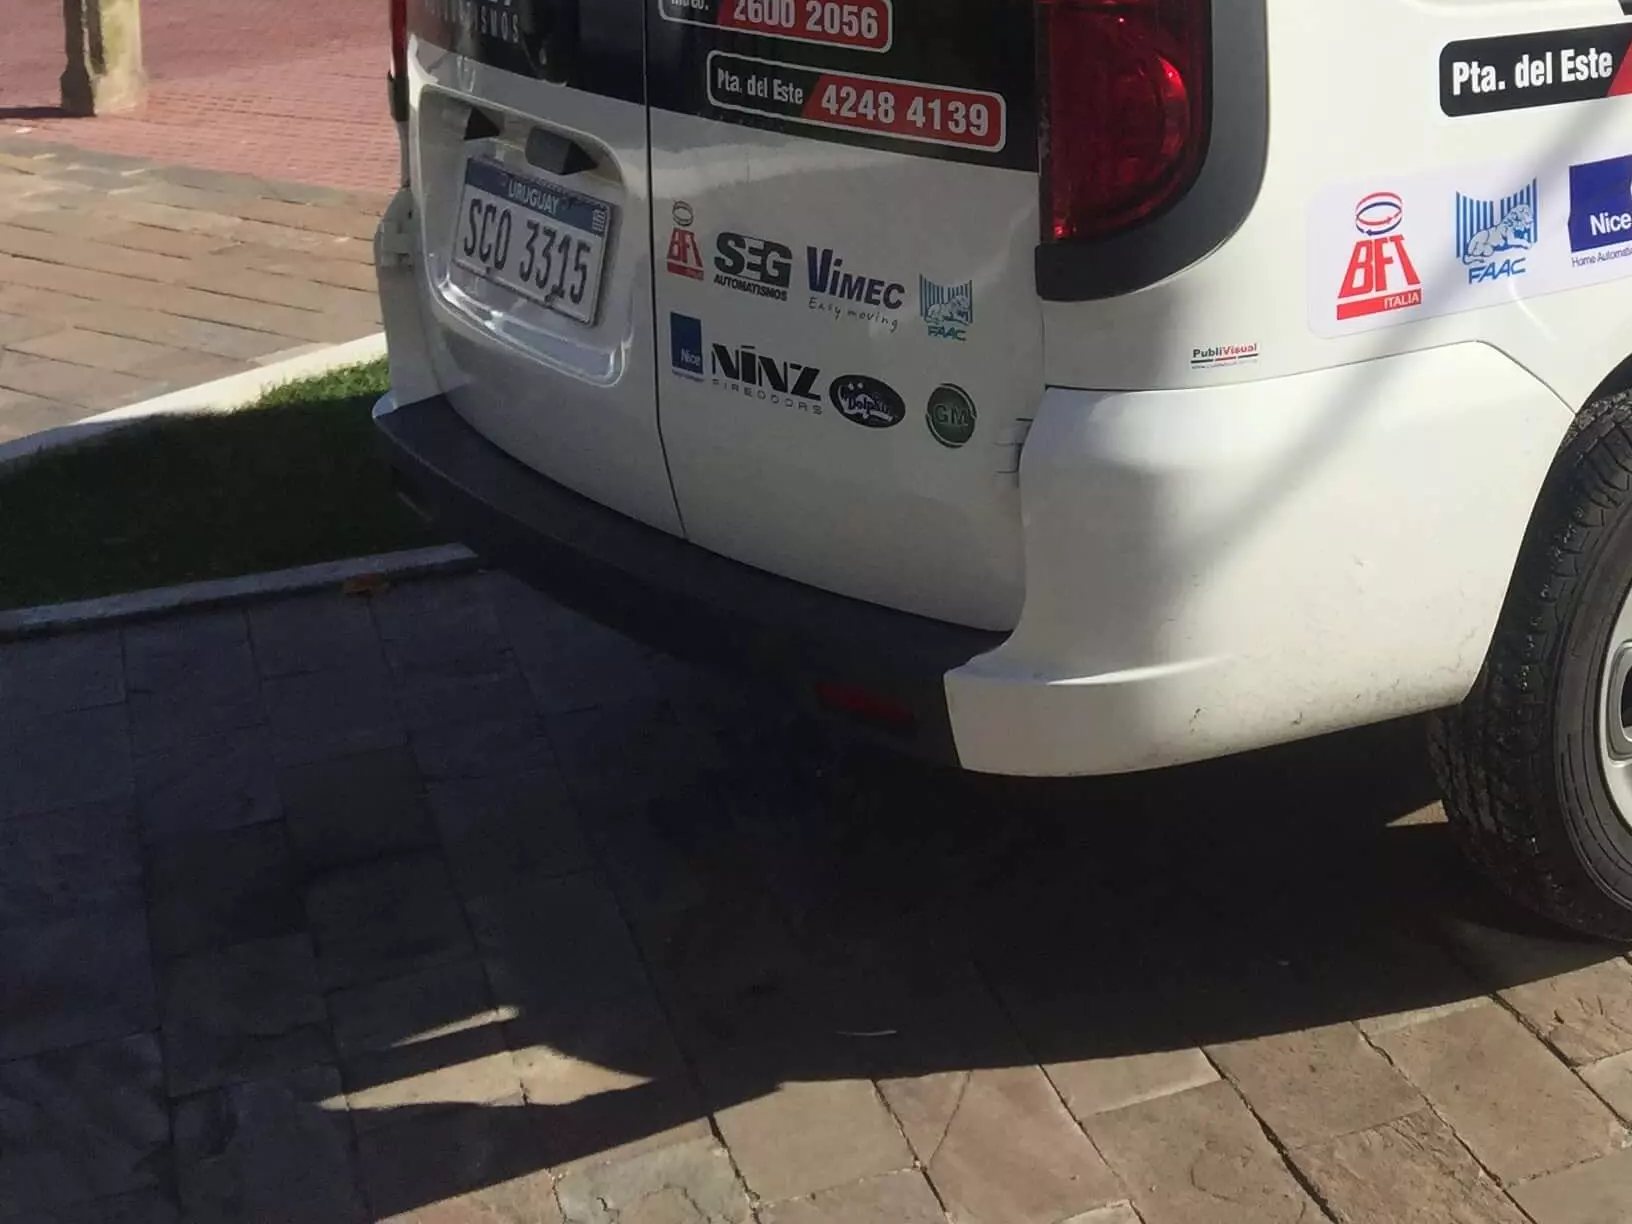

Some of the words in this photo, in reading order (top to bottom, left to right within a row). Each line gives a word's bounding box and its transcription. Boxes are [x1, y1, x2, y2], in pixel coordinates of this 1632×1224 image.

[805, 0, 879, 40] 2056
[1452, 61, 1506, 97] Pta.
[1514, 51, 1553, 89] del
[1561, 47, 1613, 82] Este
[716, 67, 743, 94] Pta.
[746, 74, 768, 98] del
[772, 78, 804, 105] Este
[821, 83, 896, 124] 4248
[906, 96, 990, 137] 4139
[508, 179, 561, 214] URUGUAY
[1590, 211, 1632, 236] Nice
[463, 198, 512, 271] SCO
[518, 219, 592, 305] 3315
[713, 231, 793, 289] SEG
[1337, 234, 1422, 300] BFT
[1572, 255, 1597, 268] Home
[713, 274, 788, 302] AUTOMATISMOS
[1468, 257, 1527, 285] FAAC
[808, 296, 841, 320] Easy
[847, 310, 899, 333] moving
[1383, 291, 1420, 310] ITALIA
[927, 326, 967, 342] FAAC
